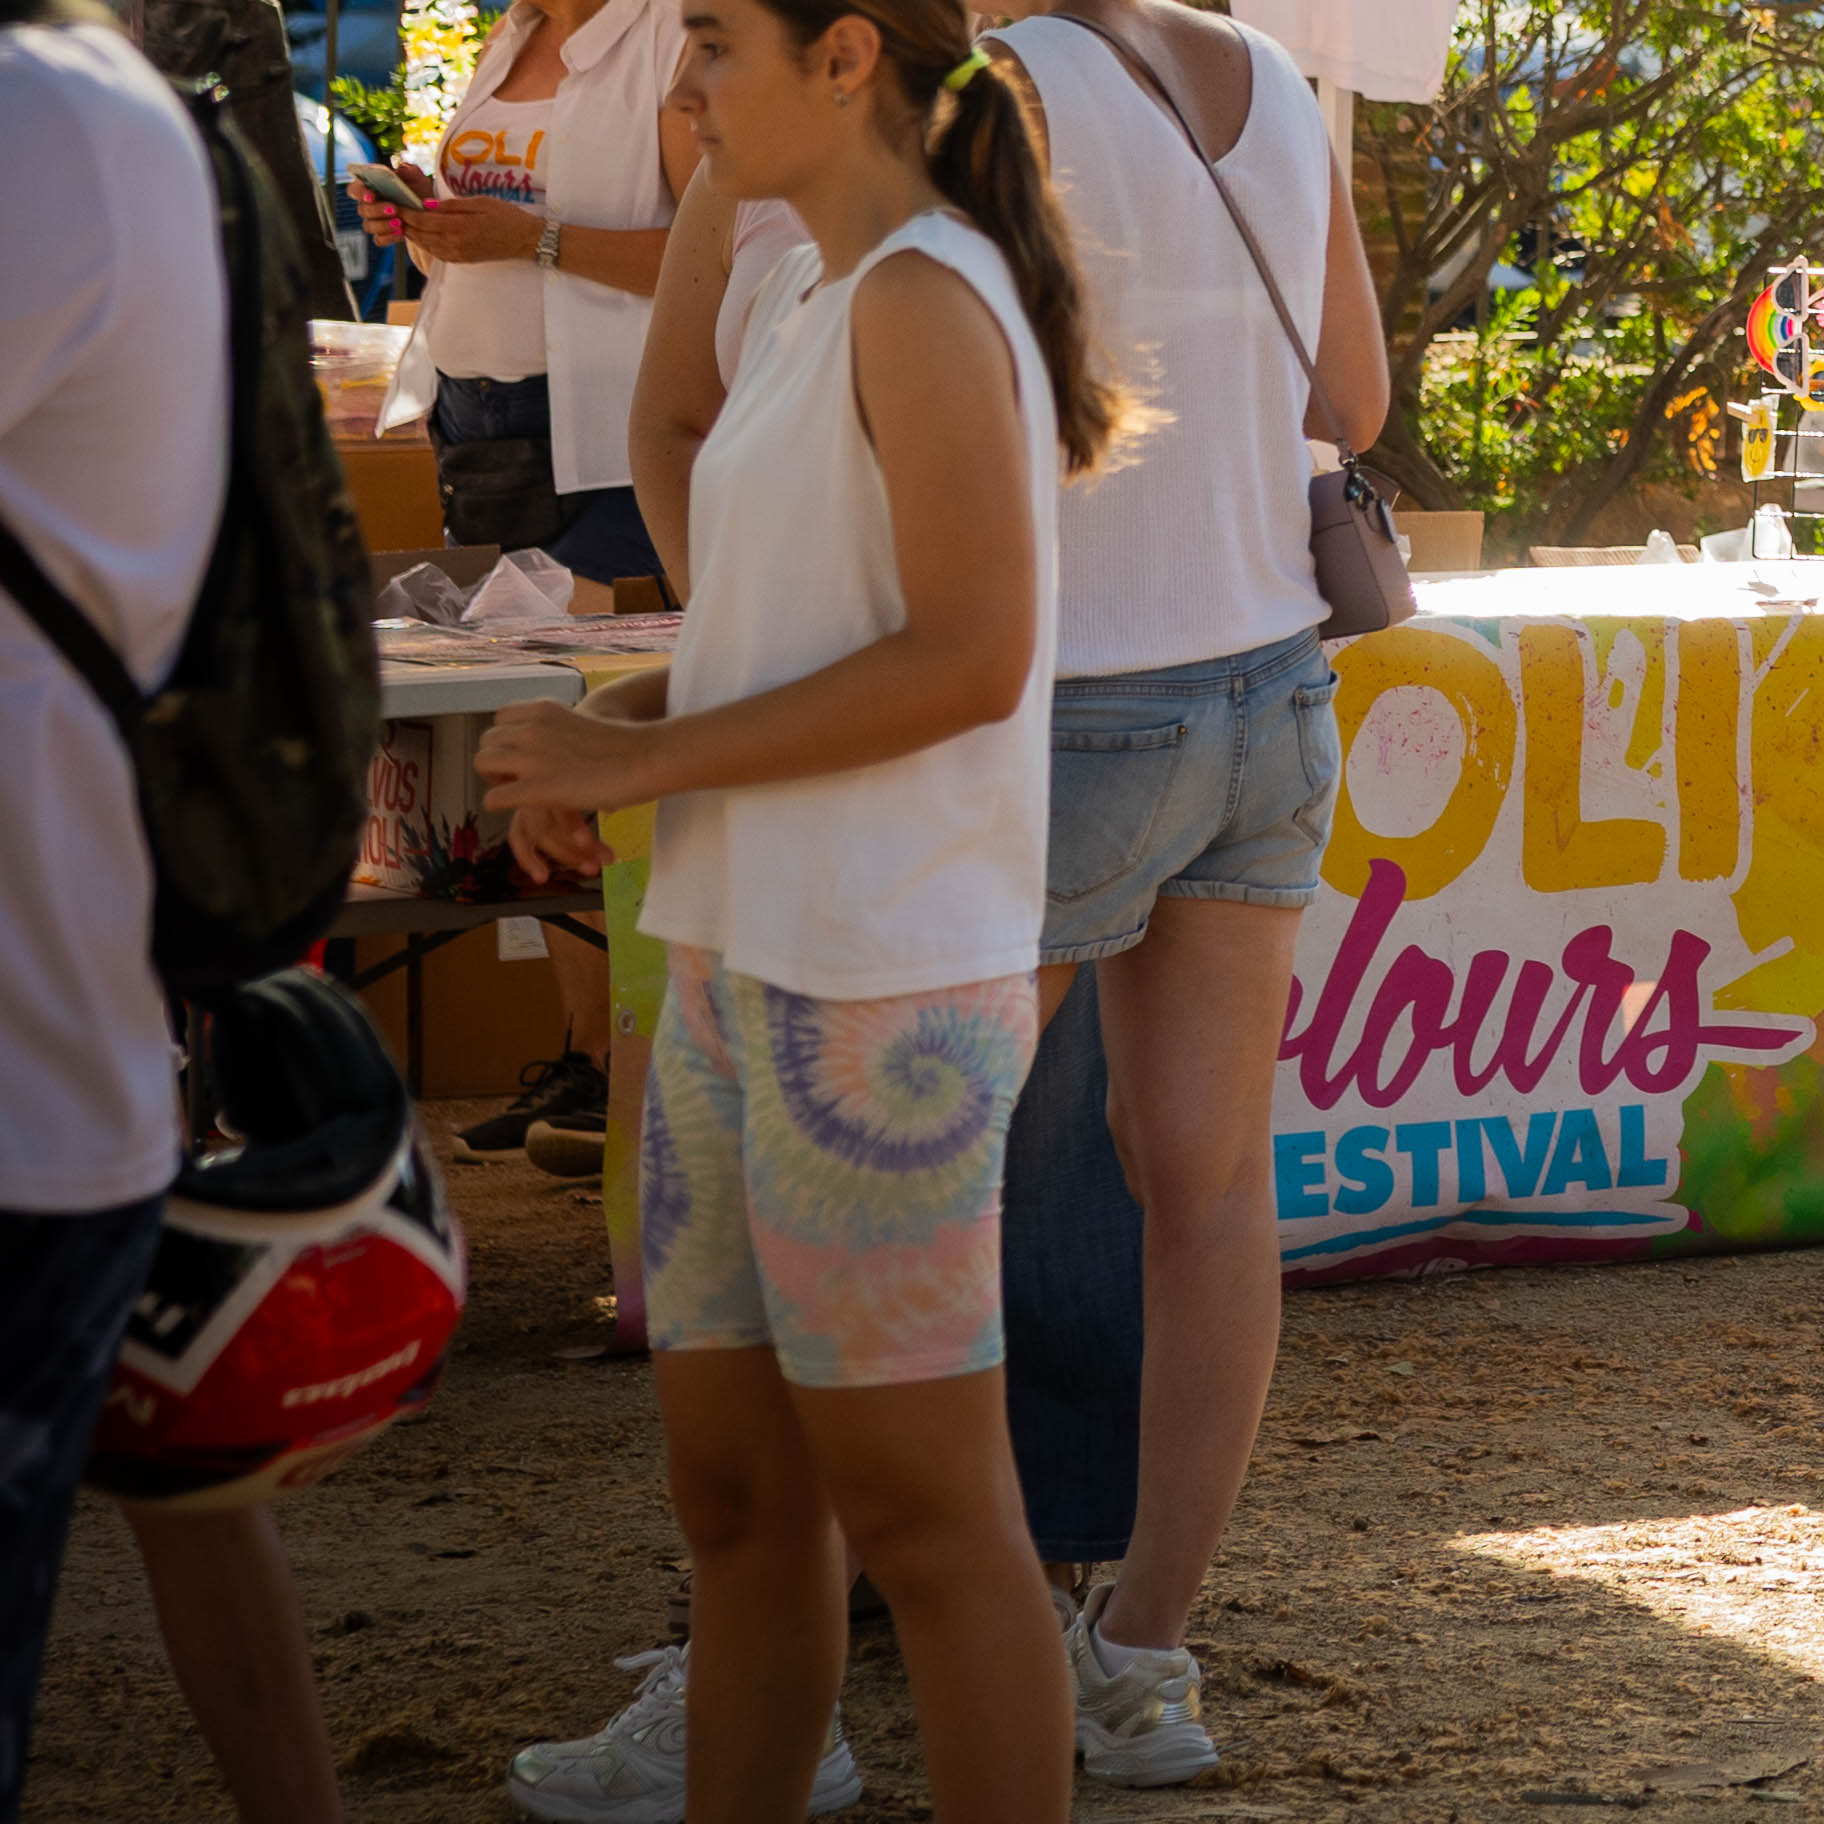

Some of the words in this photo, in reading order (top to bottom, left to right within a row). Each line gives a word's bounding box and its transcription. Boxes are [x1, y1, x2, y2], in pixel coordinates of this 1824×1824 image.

[446, 129, 545, 171] OLI
[1322, 620, 1741, 902] OLI
[1280, 858, 1803, 1113] lours
[1274, 1104, 1668, 1221] ESTIVAL
